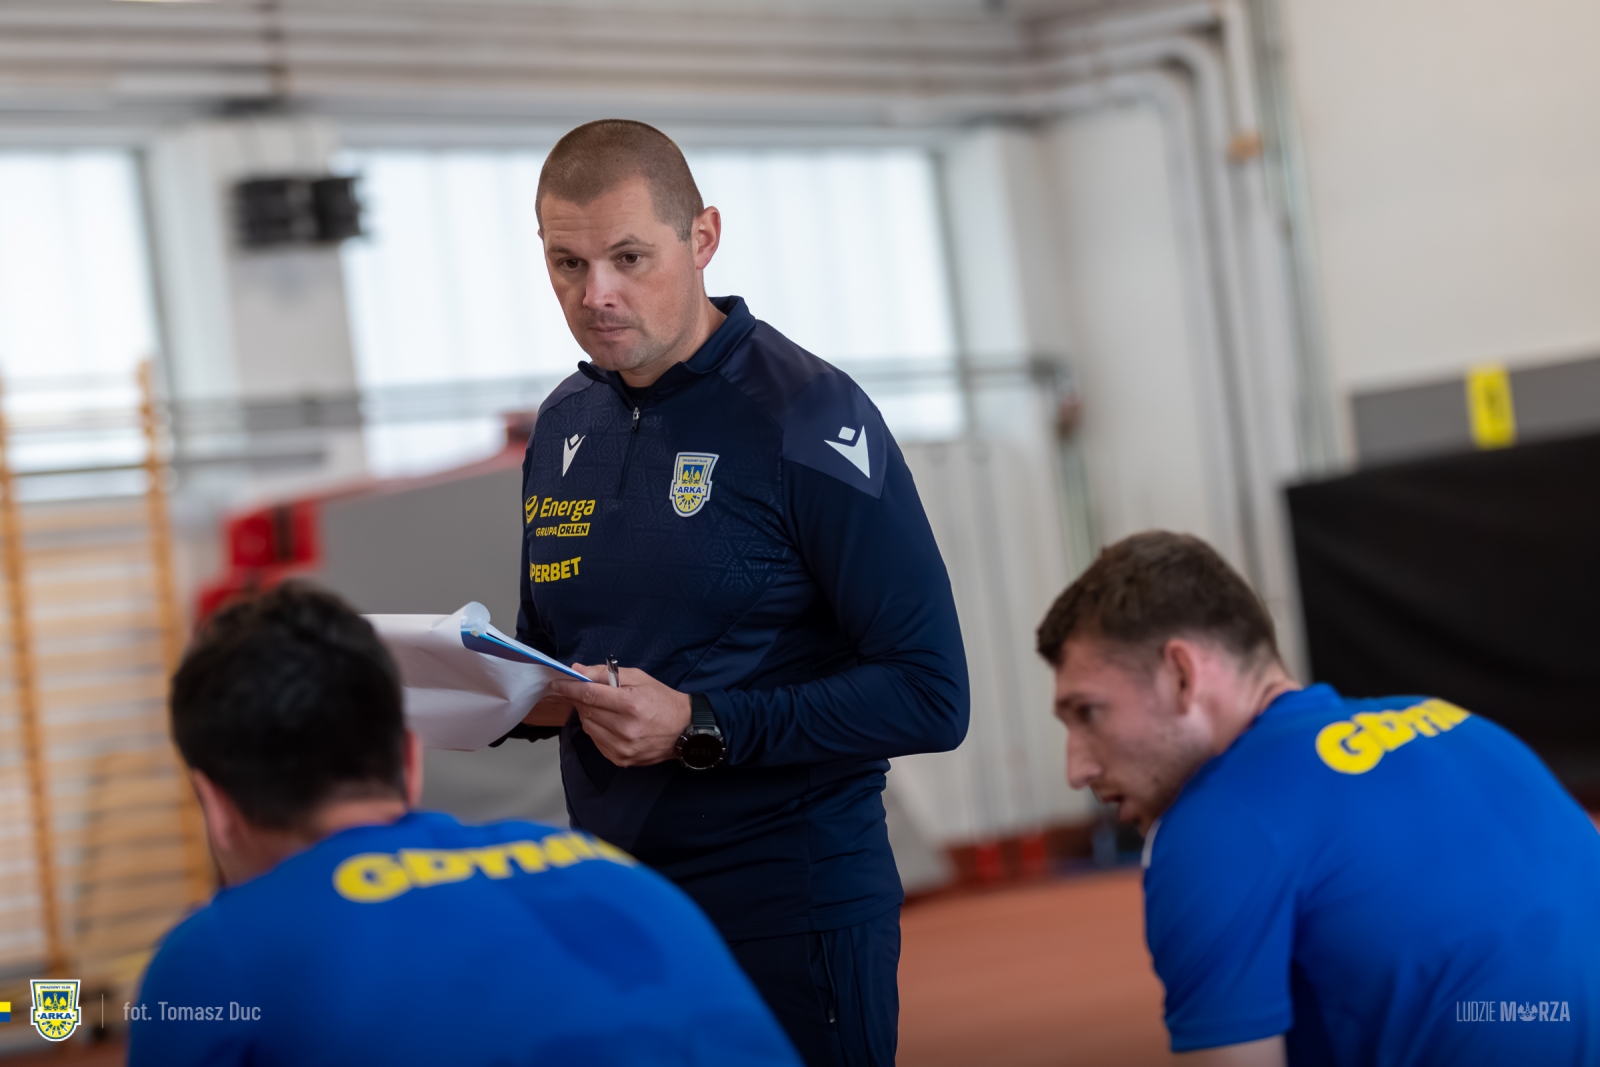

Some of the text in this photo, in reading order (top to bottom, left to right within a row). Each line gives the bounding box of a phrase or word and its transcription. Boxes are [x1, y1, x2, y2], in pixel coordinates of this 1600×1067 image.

[540, 498, 595, 521] Energa
[535, 524, 588, 537] GRUPA ORLEN
[529, 556, 582, 583] PERBET
